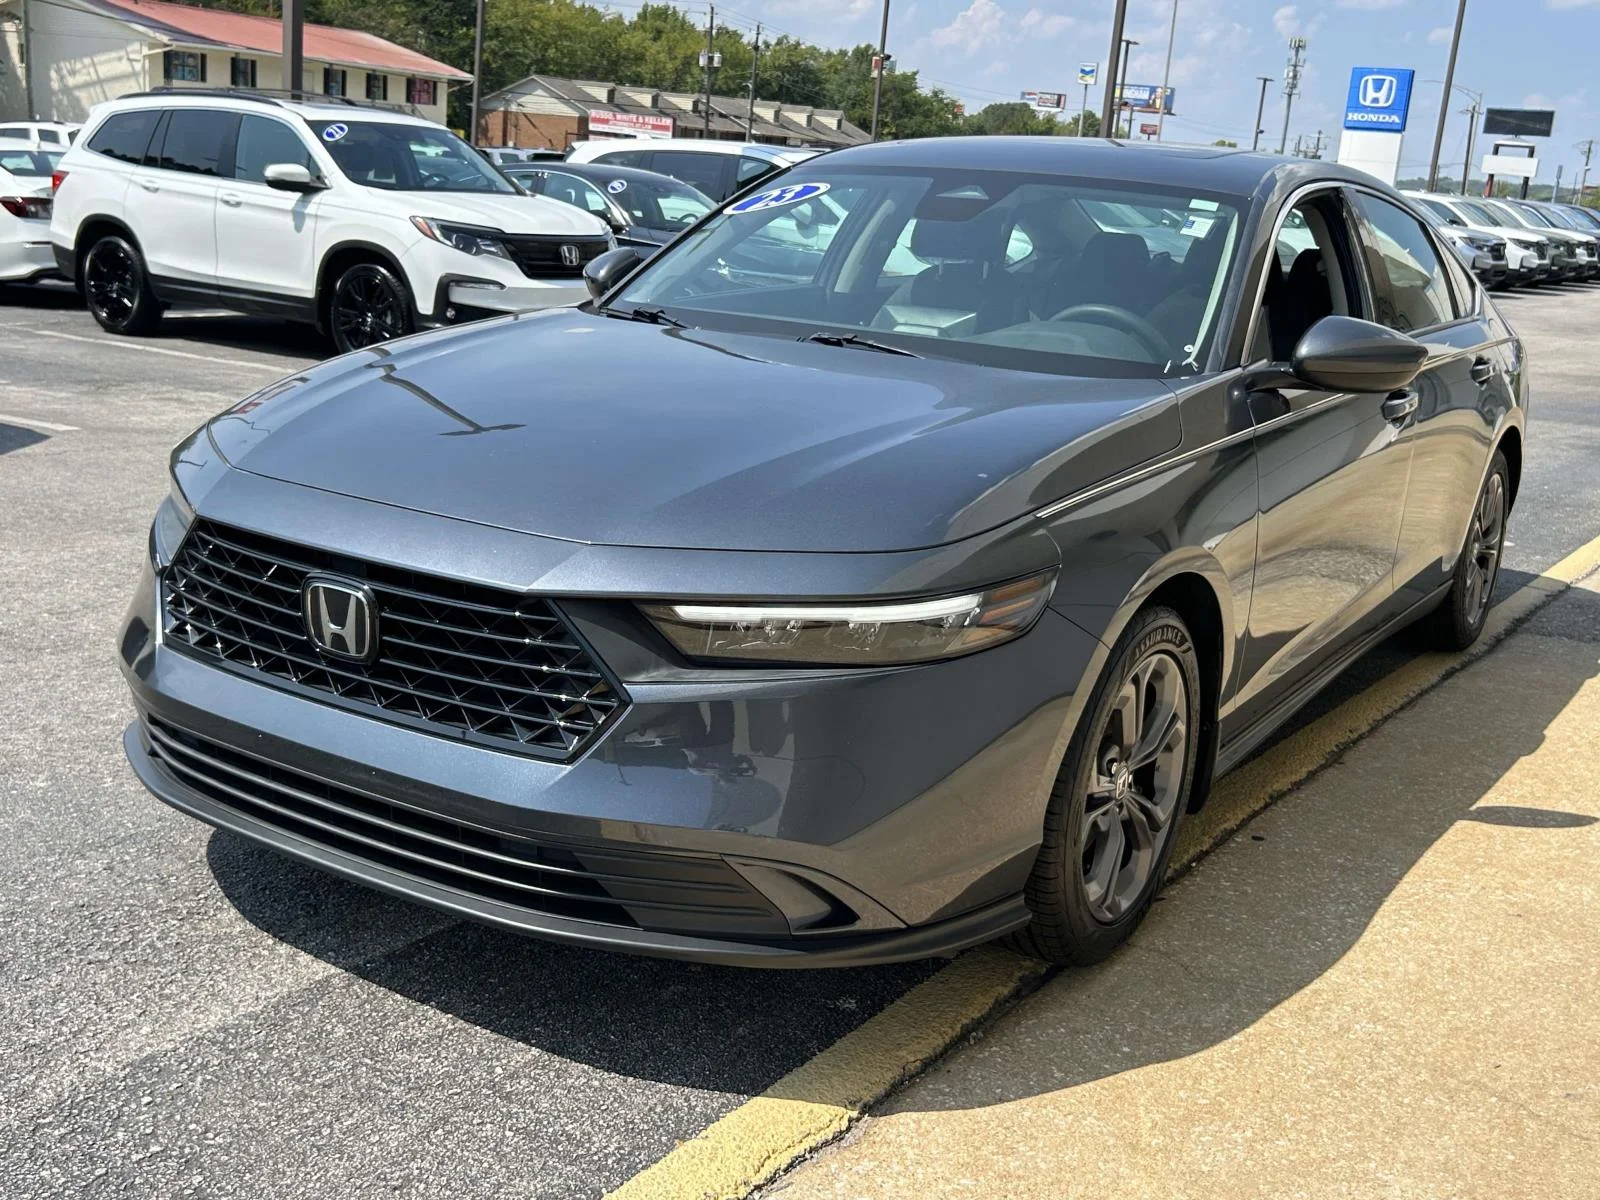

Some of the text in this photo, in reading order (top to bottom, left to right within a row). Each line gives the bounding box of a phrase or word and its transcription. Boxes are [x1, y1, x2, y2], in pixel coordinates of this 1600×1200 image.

[1347, 112, 1400, 123] HONDA
[745, 185, 805, 210] 23
[1134, 626, 1183, 659] ASSURANCE
